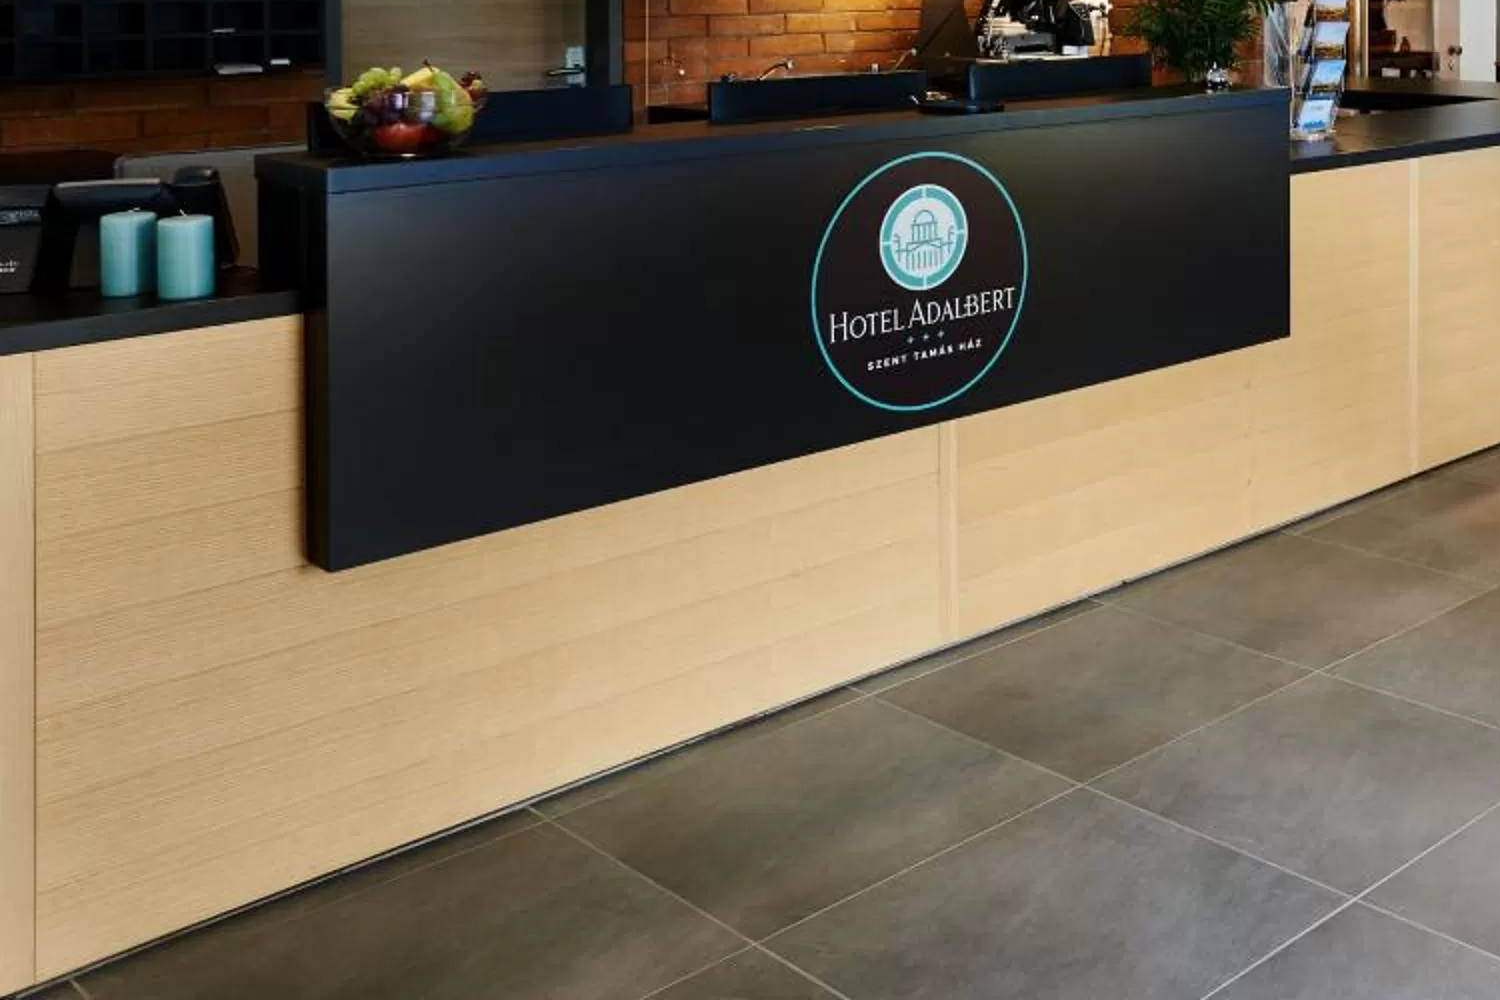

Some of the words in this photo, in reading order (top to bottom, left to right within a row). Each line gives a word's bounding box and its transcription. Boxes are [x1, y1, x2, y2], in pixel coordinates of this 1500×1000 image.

[830, 308, 904, 344] HOTEL
[908, 286, 1016, 329] ADALBERT
[867, 354, 907, 371] SZENT
[913, 343, 954, 361] TAMÁS
[959, 337, 982, 351] HÁZ
